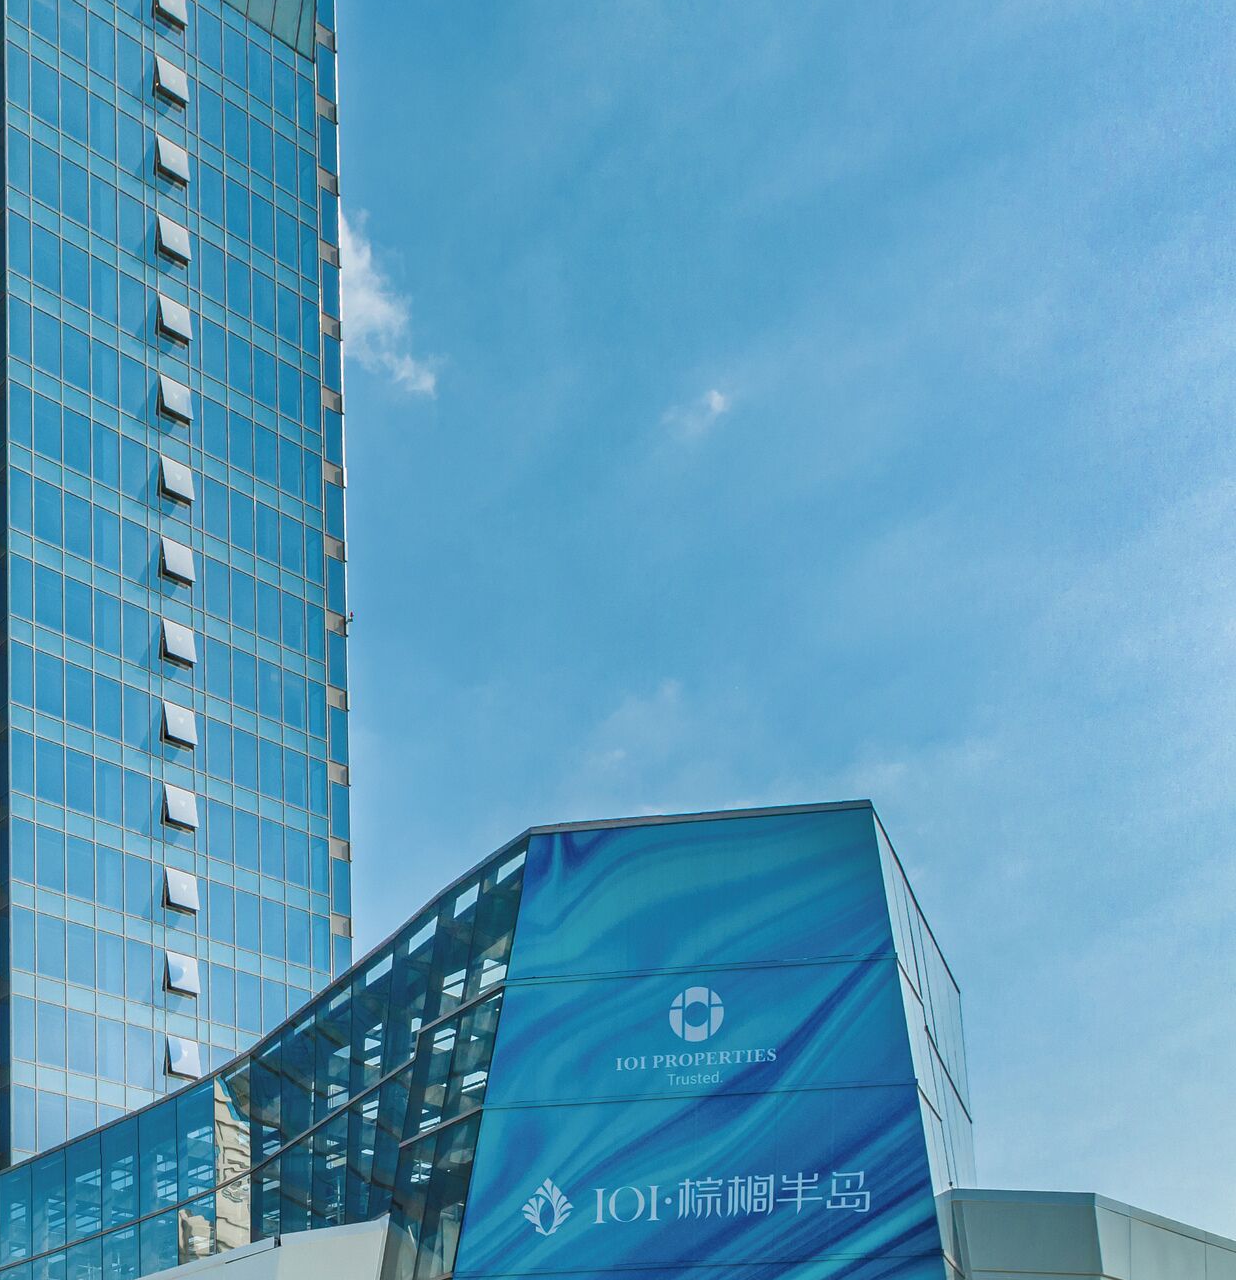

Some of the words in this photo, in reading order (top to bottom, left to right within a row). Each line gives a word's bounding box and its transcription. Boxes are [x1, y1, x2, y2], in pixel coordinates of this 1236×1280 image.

[616, 1056, 646, 1072] IOI
[652, 1048, 778, 1070] PROPERTIES
[667, 1071, 724, 1087] Trusted.
